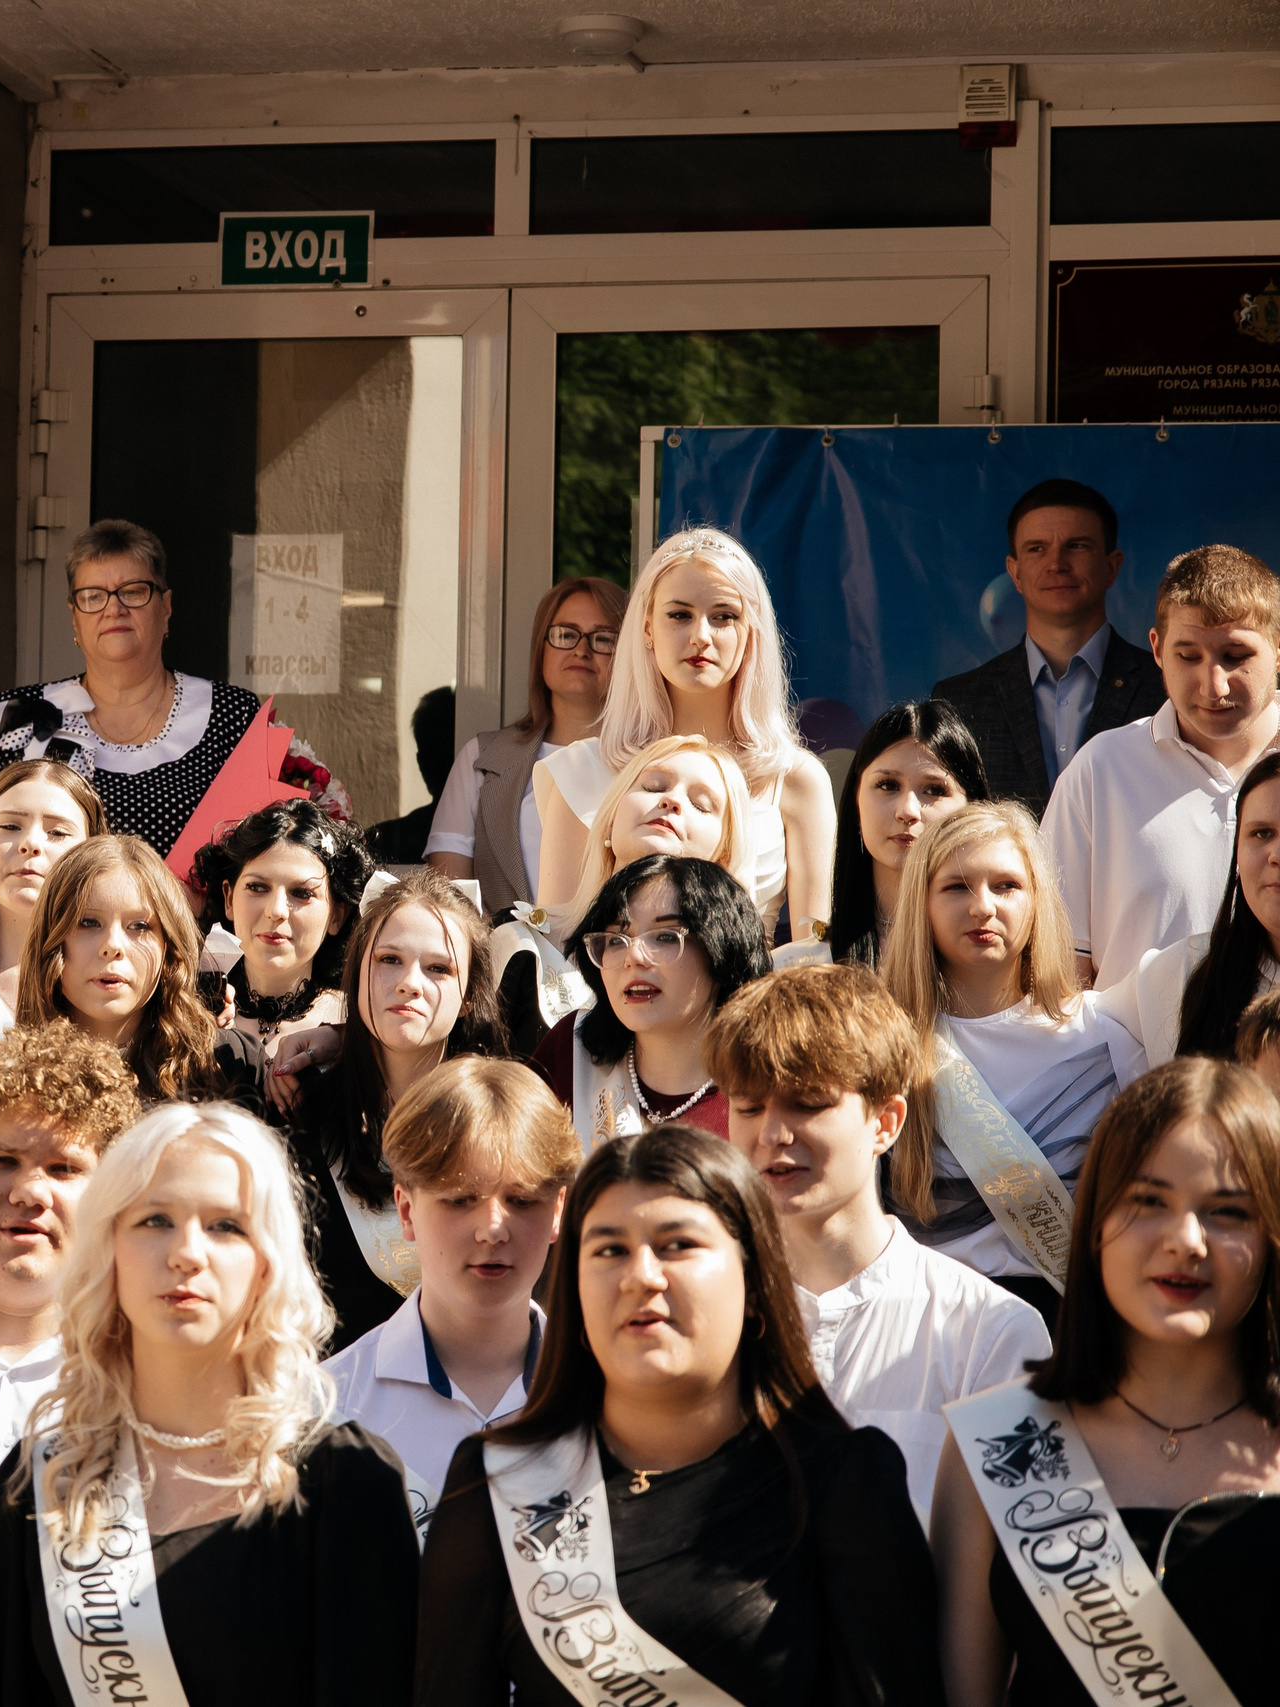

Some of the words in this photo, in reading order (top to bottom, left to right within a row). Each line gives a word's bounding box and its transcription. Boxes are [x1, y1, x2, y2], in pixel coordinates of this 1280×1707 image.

[245, 230, 346, 275] ВХОД
[1105, 364, 1213, 376] МУНИЦИПАЛЬНОЕ
[1217, 363, 1280, 375] ОБРАЗОВА
[1158, 379, 1200, 390] ГОРОД
[1204, 378, 1247, 389] РЯЗАНЬ
[1251, 377, 1280, 388] РЯЗА
[1172, 403, 1280, 416] МУНИЦИПАЛЬНО
[256, 544, 319, 578] ВХОД
[245, 654, 327, 676] классы
